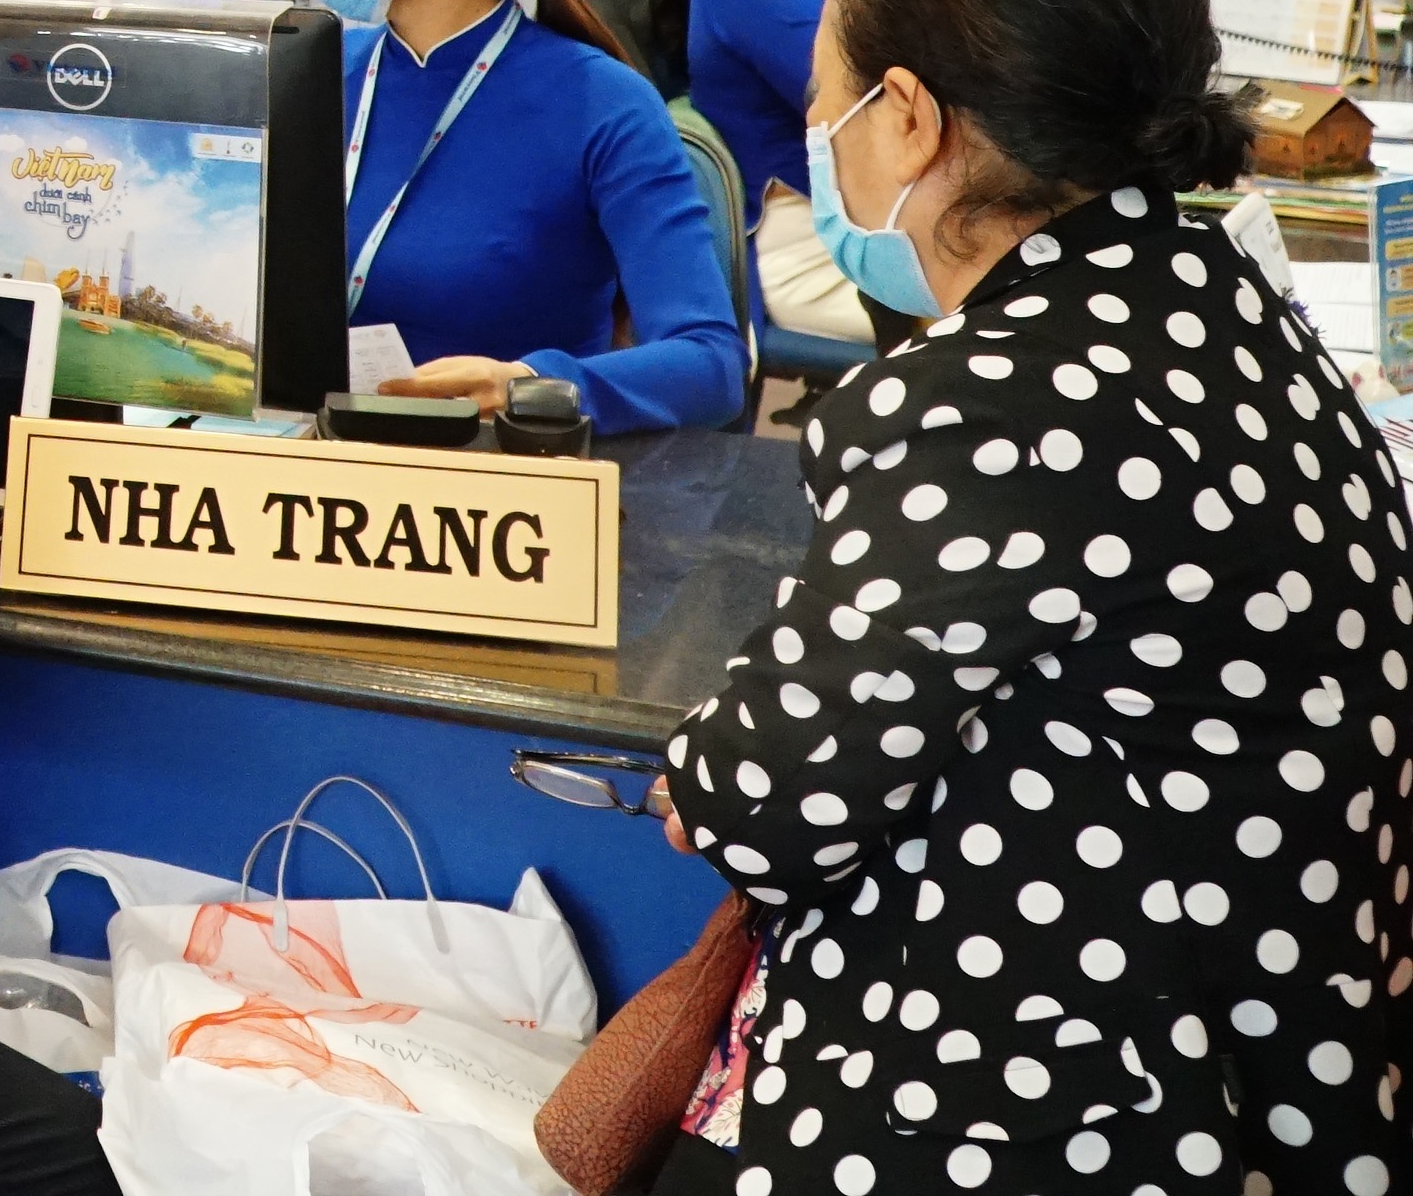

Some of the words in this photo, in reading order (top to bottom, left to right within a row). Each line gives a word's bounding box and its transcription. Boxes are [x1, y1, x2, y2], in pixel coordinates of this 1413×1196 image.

[54, 67, 105, 87] DELL
[11, 145, 66, 182] Việt
[59, 157, 116, 191] Nam
[24, 190, 61, 218] chim
[62, 202, 91, 240] bay
[64, 474, 236, 556] NHA
[262, 491, 551, 585] TRANG
[354, 1033, 423, 1064] New
